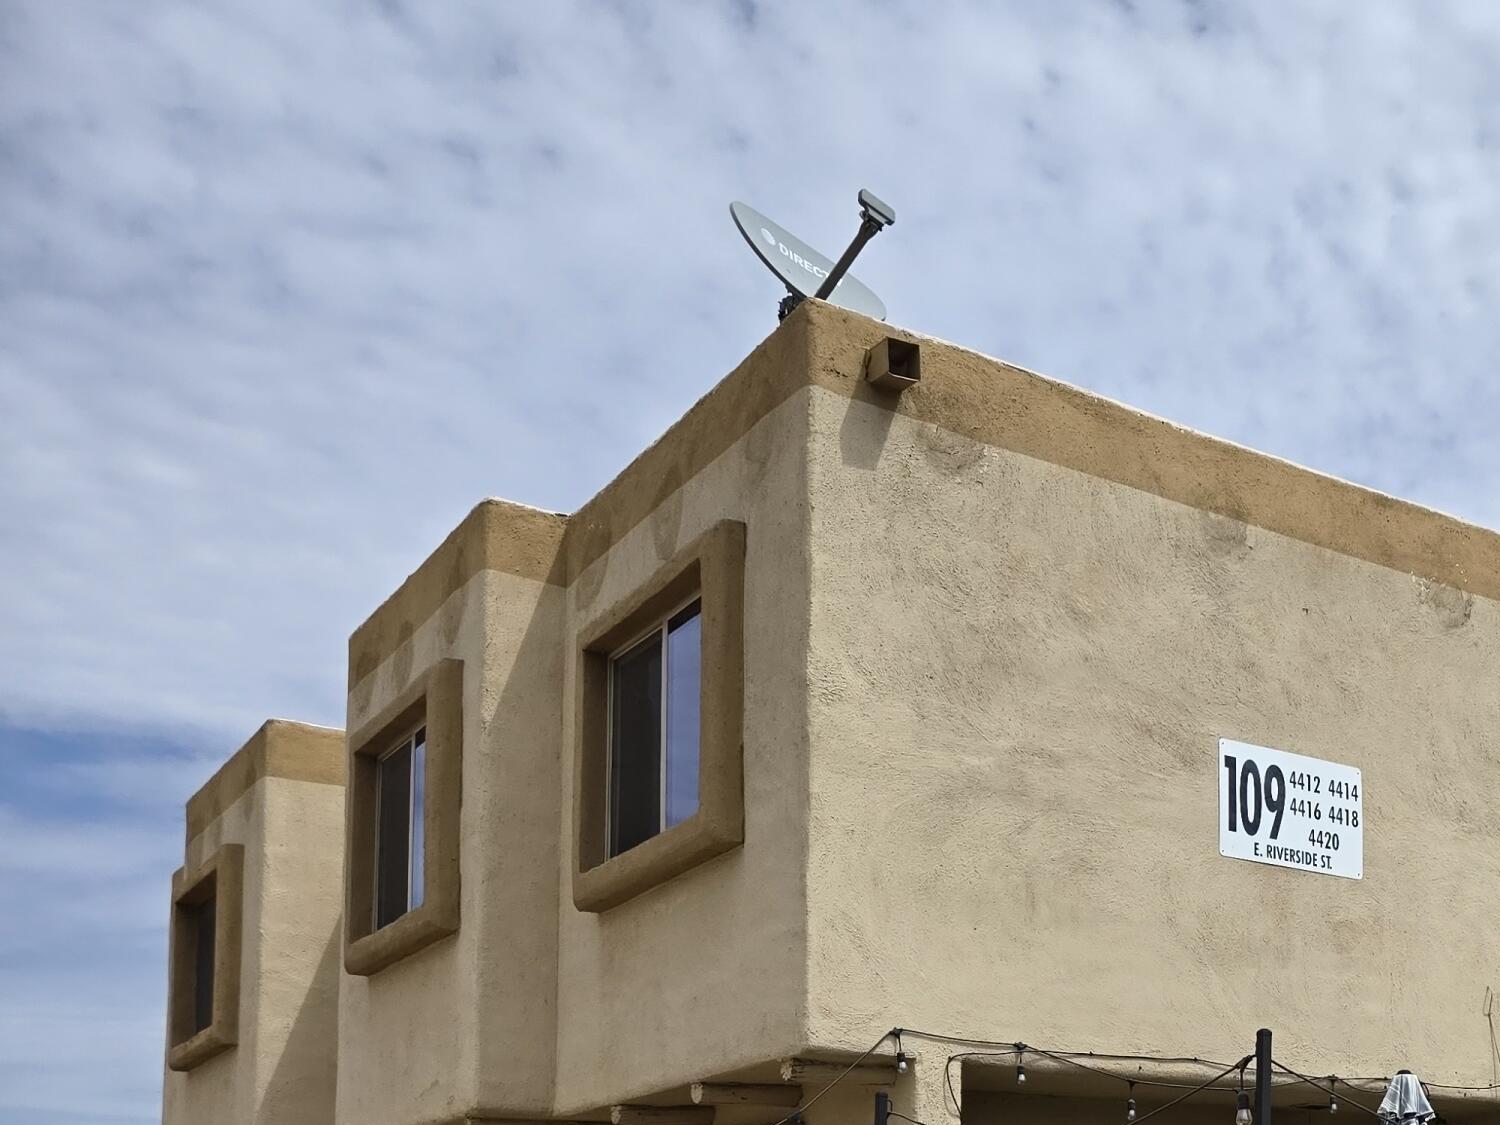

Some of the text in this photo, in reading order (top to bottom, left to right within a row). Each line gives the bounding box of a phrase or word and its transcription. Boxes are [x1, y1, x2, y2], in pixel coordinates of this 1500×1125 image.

[1224, 755, 1286, 840] 109
[1289, 771, 1358, 802] 4412 4414
[1290, 798, 1359, 828] 4416 4418
[1308, 829, 1340, 851] 4420
[1254, 842, 1333, 870] E. RIVERSIDE ST.
